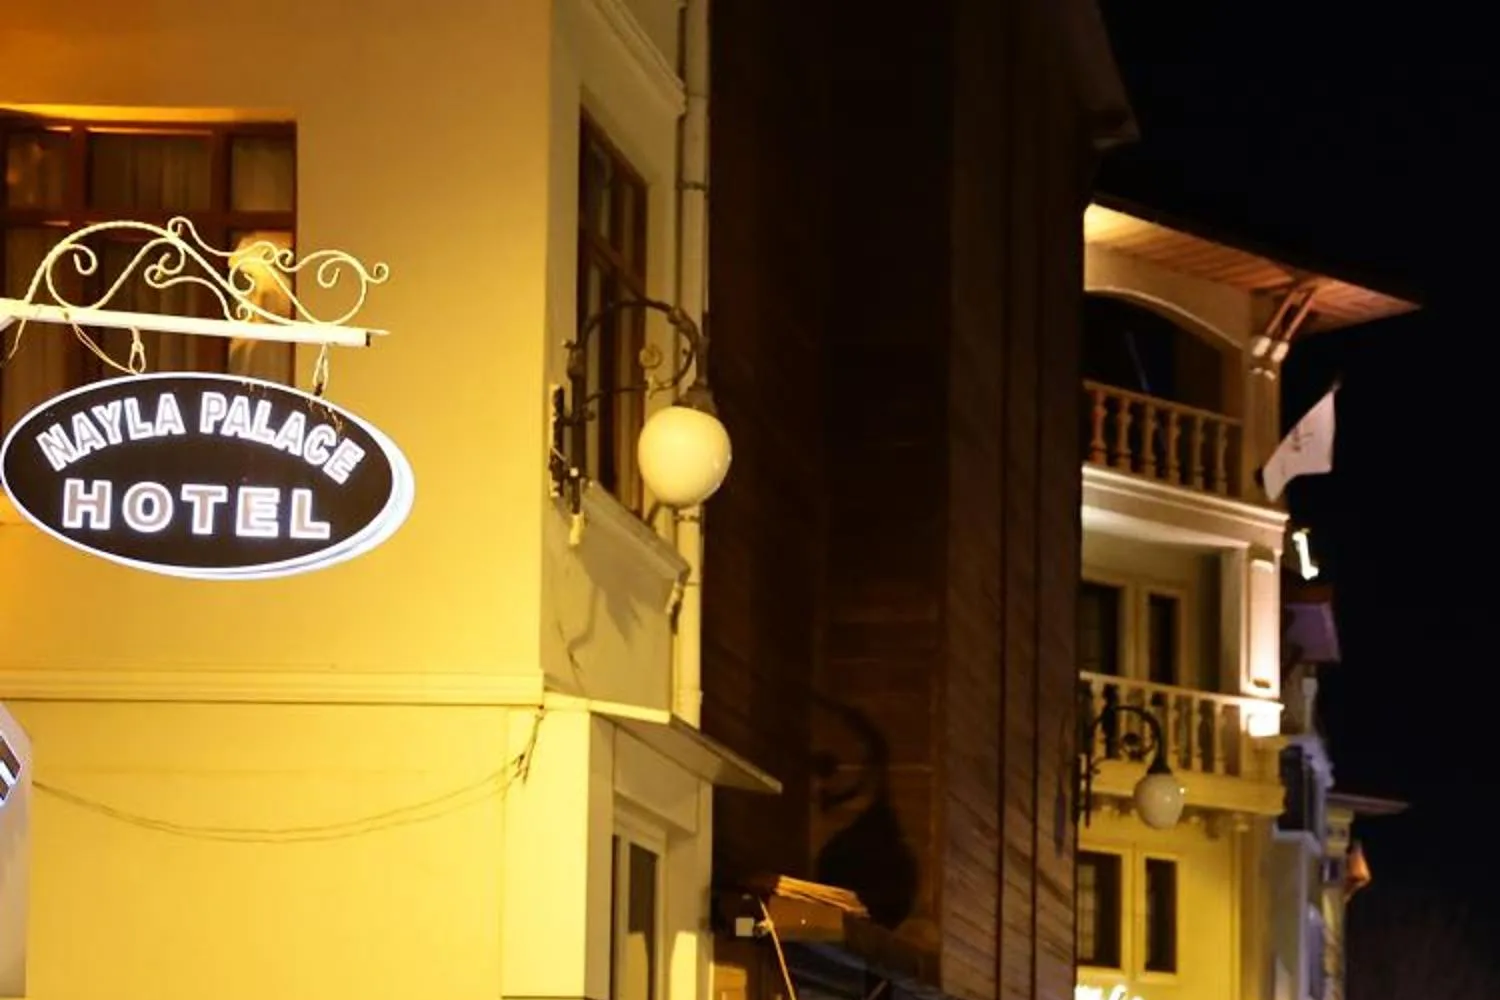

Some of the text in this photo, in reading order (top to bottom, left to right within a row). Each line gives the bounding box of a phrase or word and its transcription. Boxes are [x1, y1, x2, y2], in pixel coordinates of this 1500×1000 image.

[35, 391, 366, 485] NAYLA PALACE
[61, 477, 331, 539] HOTEL
